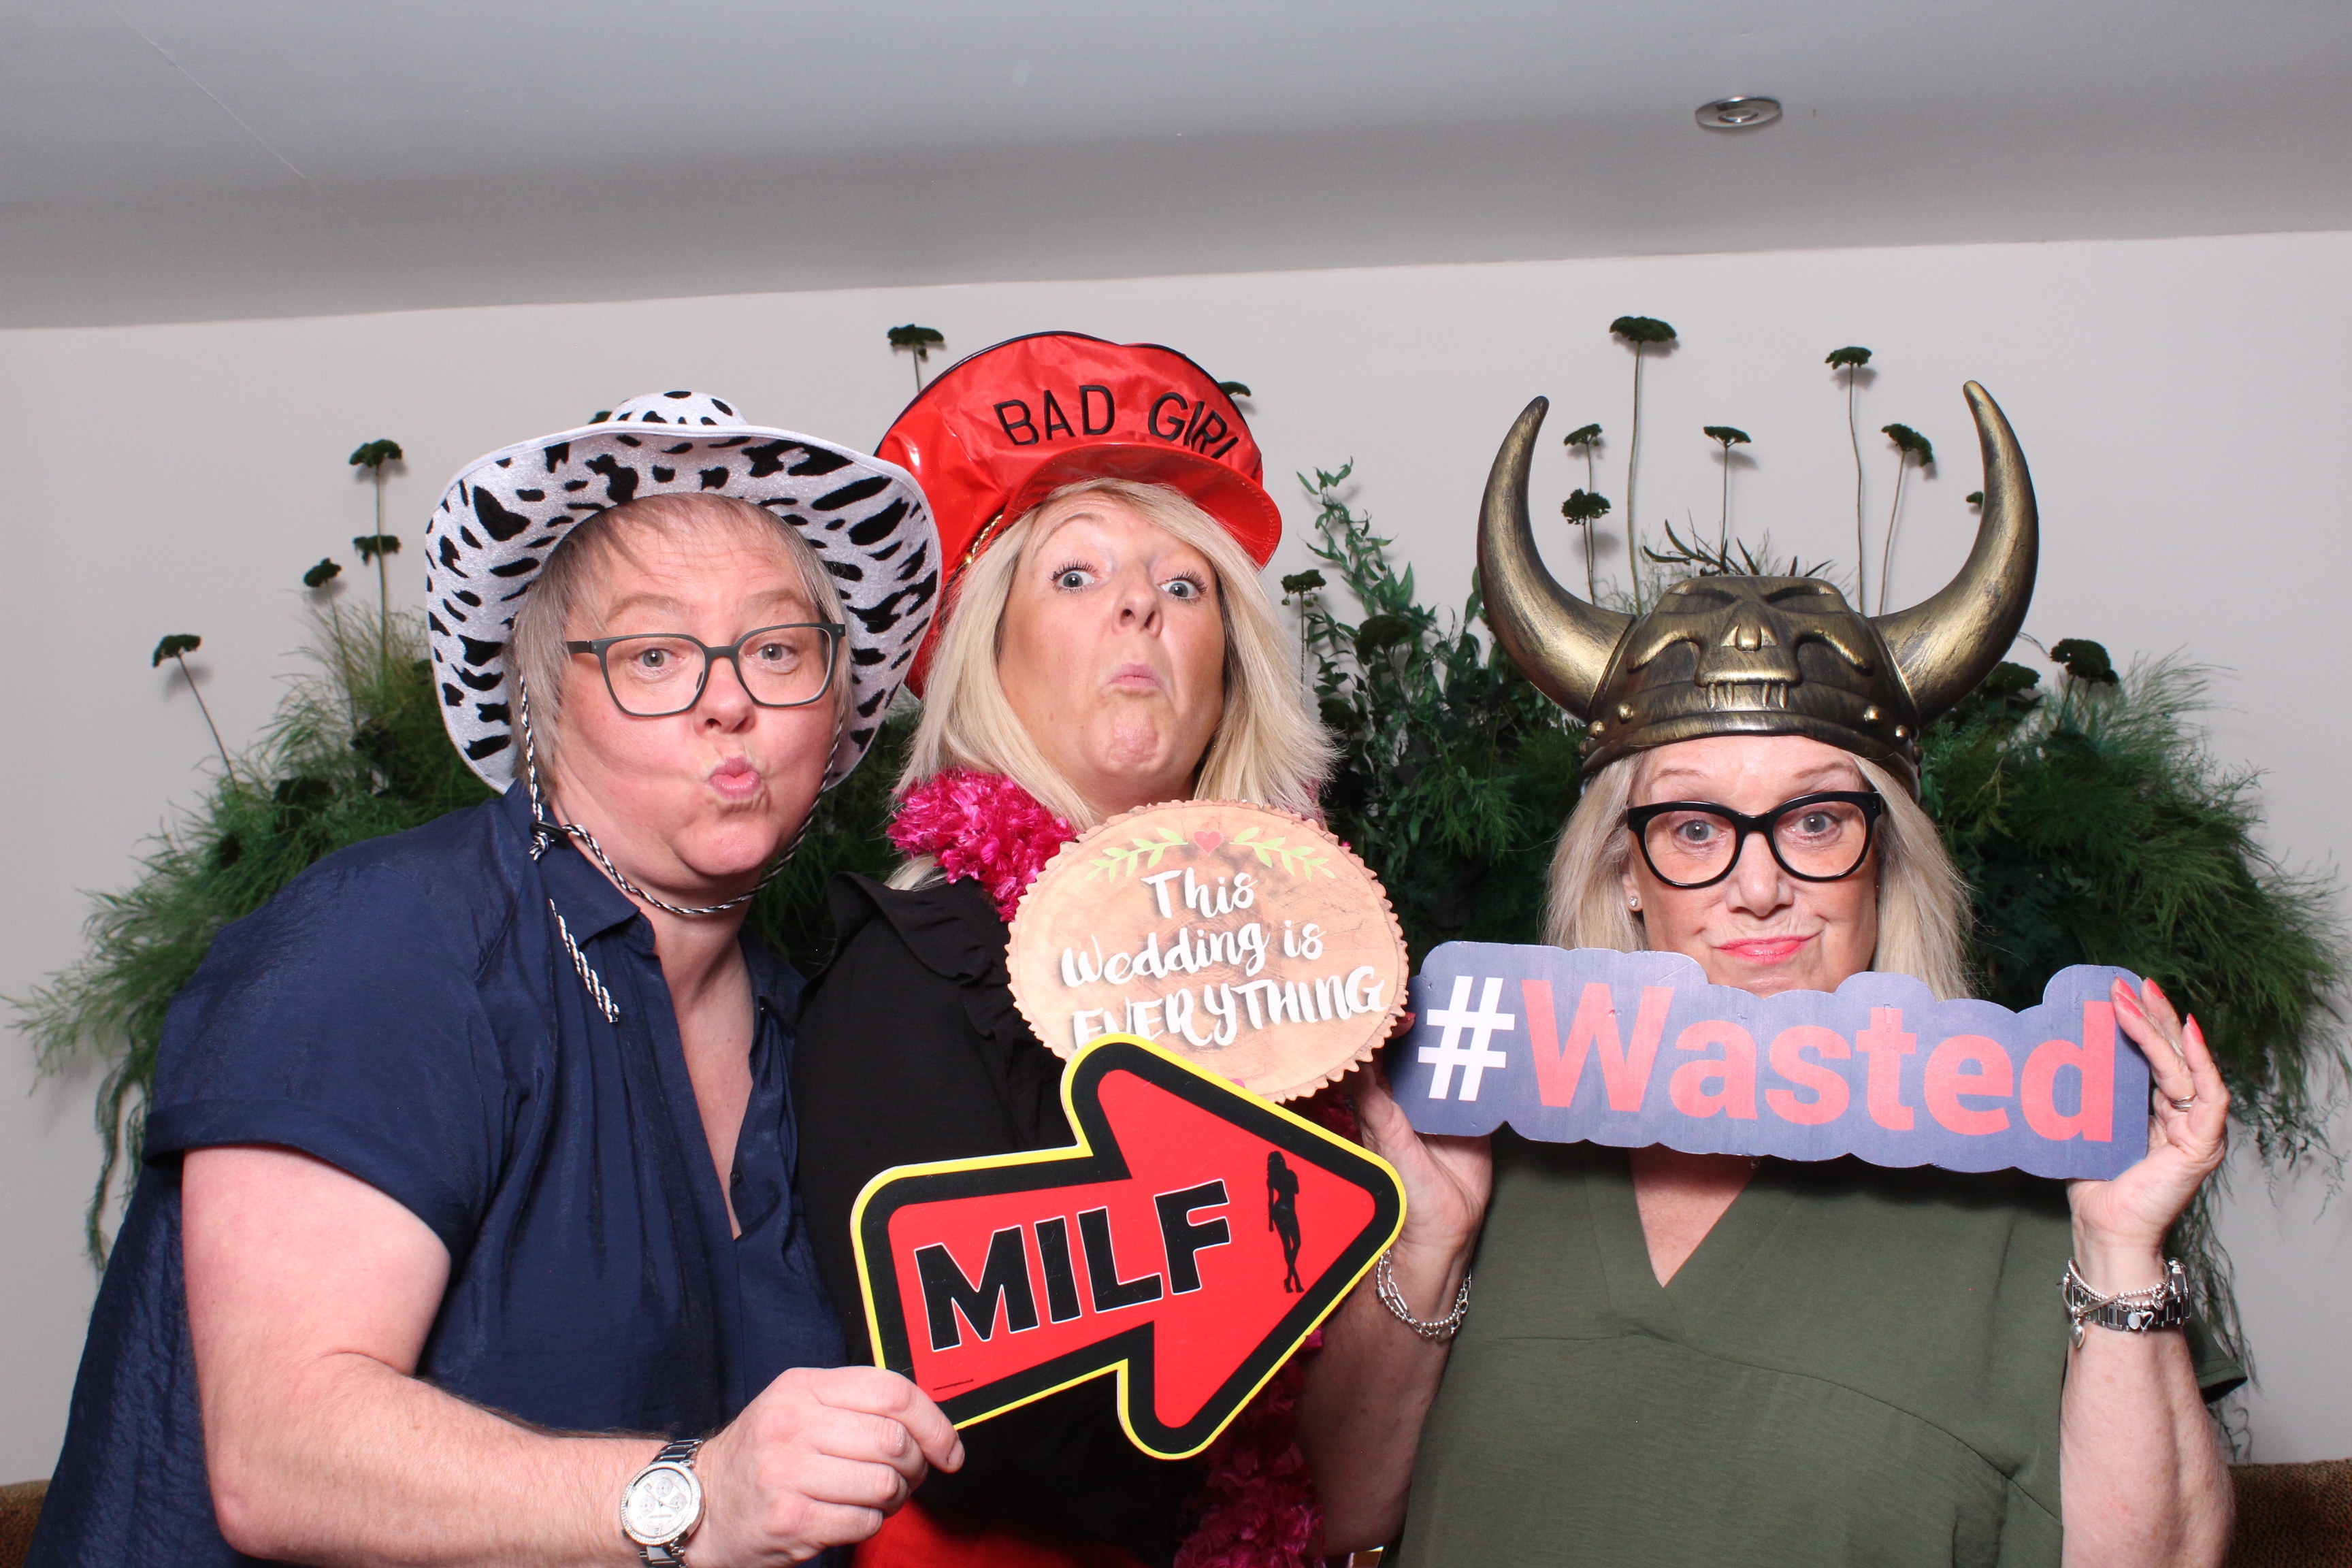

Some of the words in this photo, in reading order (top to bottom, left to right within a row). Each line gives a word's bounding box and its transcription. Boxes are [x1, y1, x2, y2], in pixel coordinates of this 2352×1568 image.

[993, 385, 1115, 445] BAD
[1141, 866, 1258, 918] This
[1062, 922, 1270, 987] Wedding
[1284, 919, 1327, 960] is
[1418, 975, 2117, 1142] #Wasted
[914, 1178, 1231, 1352] MILF
